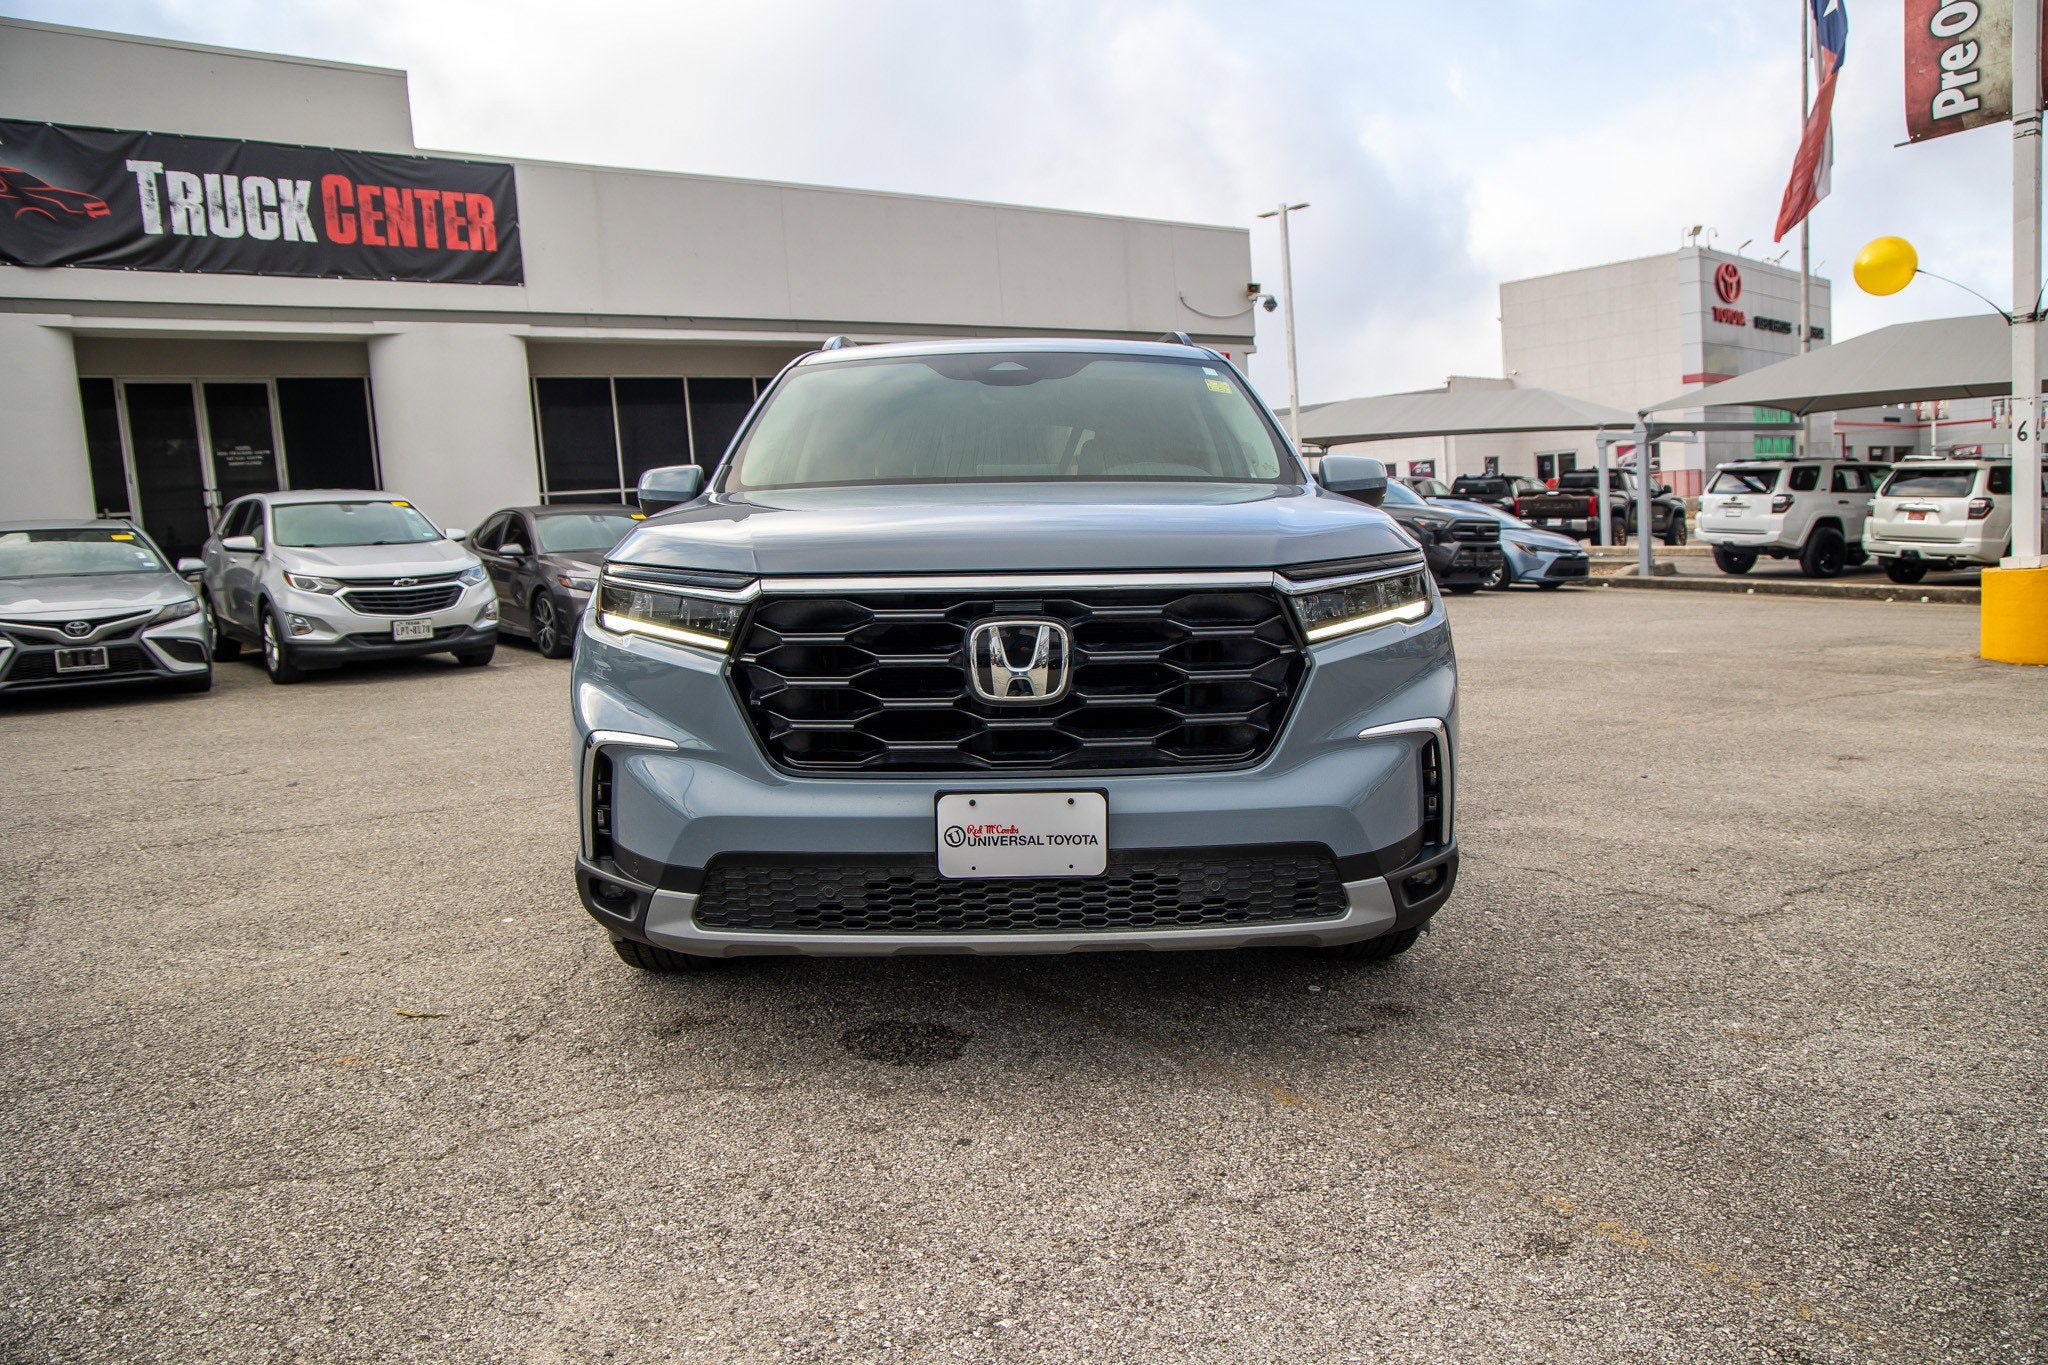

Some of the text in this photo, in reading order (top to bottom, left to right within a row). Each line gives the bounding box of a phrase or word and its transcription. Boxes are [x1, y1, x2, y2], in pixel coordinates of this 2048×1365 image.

[1930, 0, 1980, 120] Pre O
[126, 159, 498, 252] TRUCK CENTER
[2017, 420, 2028, 442] 6
[967, 824, 983, 838] Red
[967, 834, 1099, 847] UNIVERSAL TOYOTA
